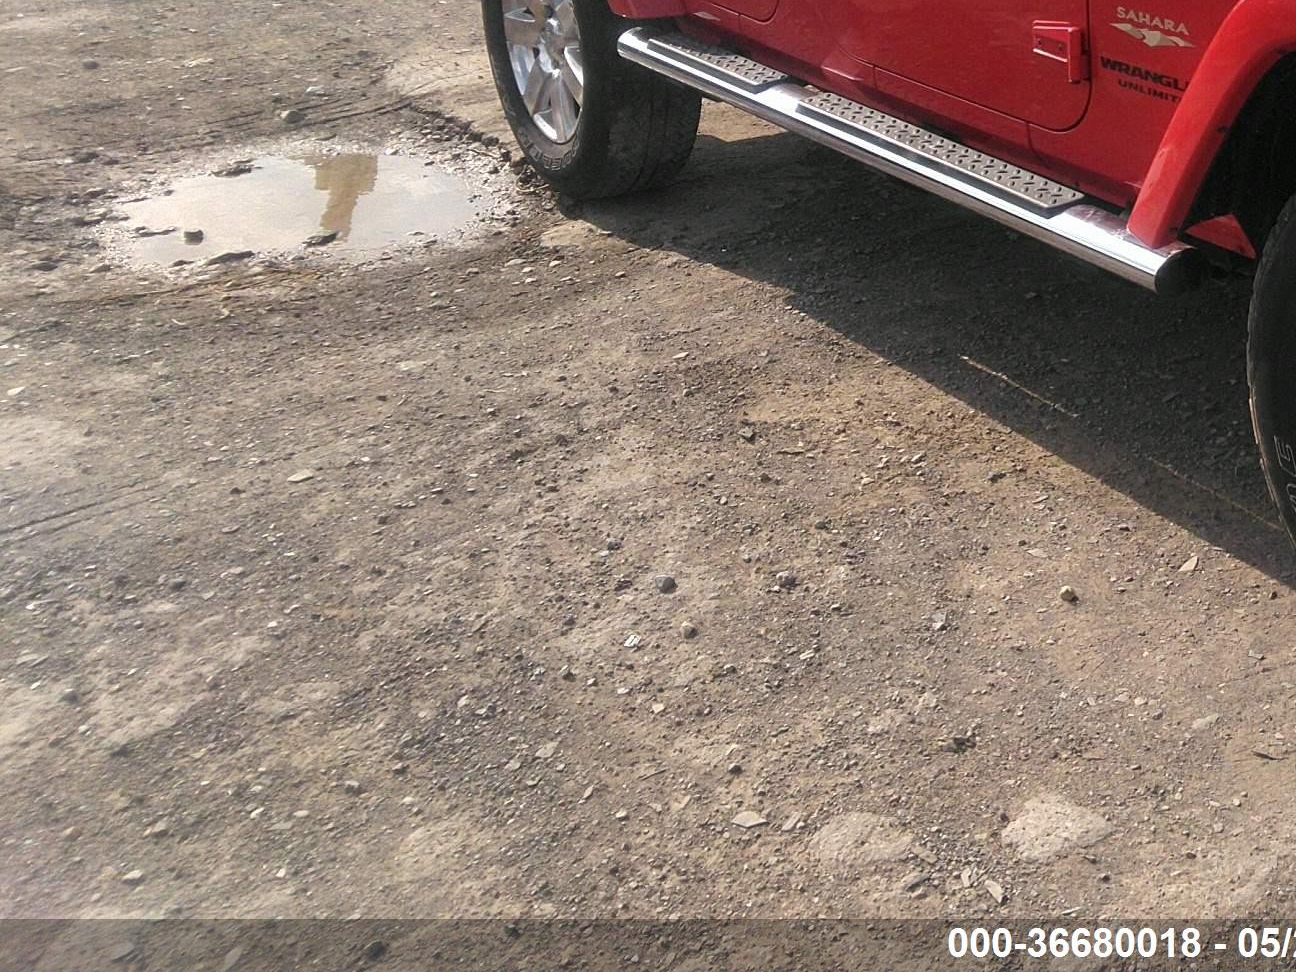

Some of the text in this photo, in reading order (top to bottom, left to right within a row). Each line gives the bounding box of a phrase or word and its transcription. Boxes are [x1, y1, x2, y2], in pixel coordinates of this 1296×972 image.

[1116, 6, 1190, 36] SAHARA
[1100, 55, 1191, 92] WRANGL
[1117, 78, 1182, 103] UNLIMIT
